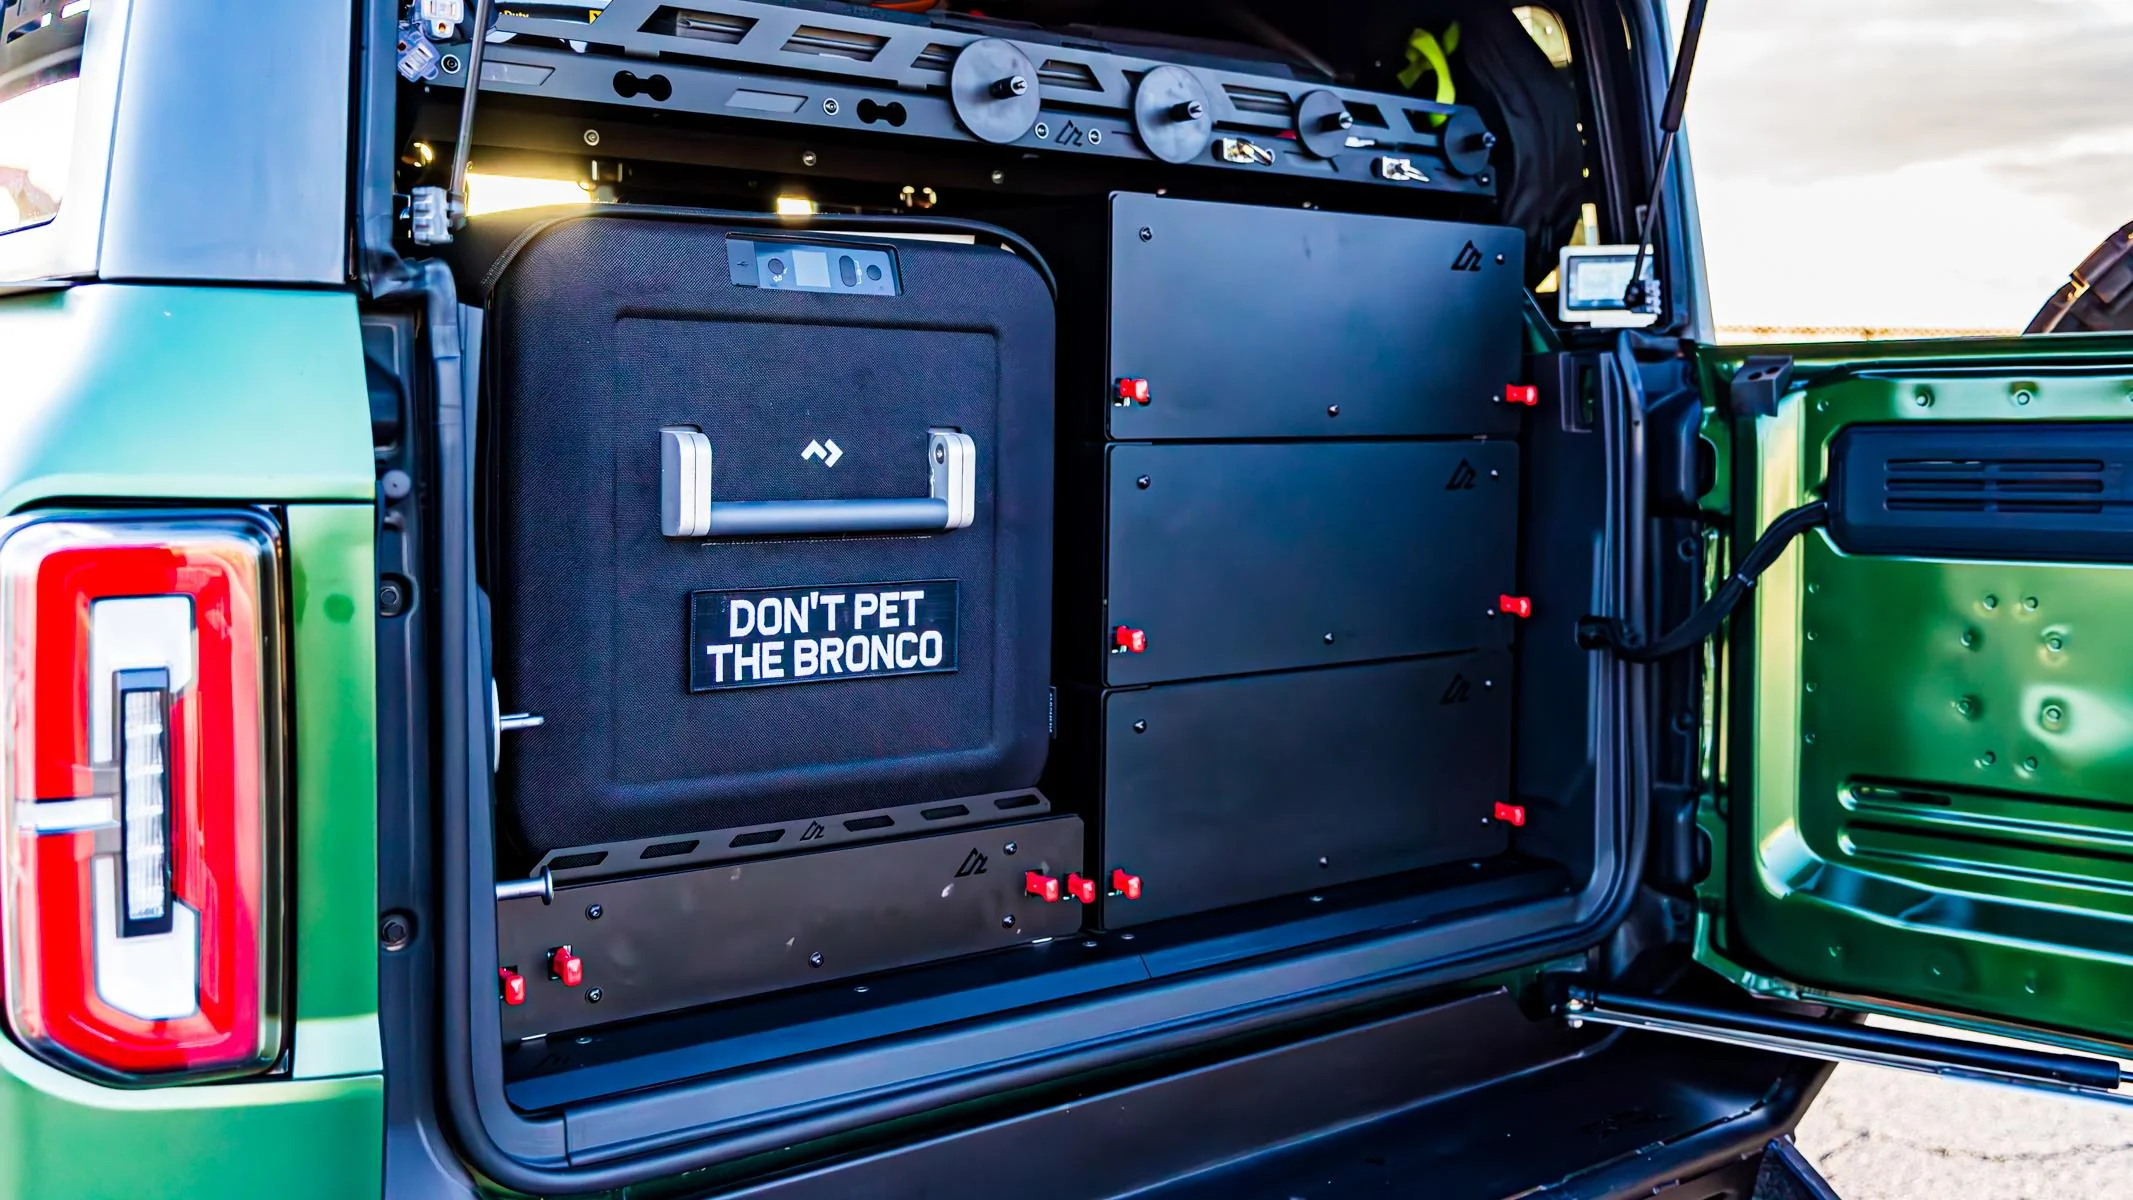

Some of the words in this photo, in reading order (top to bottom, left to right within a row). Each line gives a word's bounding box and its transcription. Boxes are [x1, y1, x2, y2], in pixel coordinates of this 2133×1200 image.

[729, 591, 846, 638] DON'T
[853, 590, 925, 630] PET
[706, 640, 785, 683] THE
[793, 630, 943, 678] BRONCO
